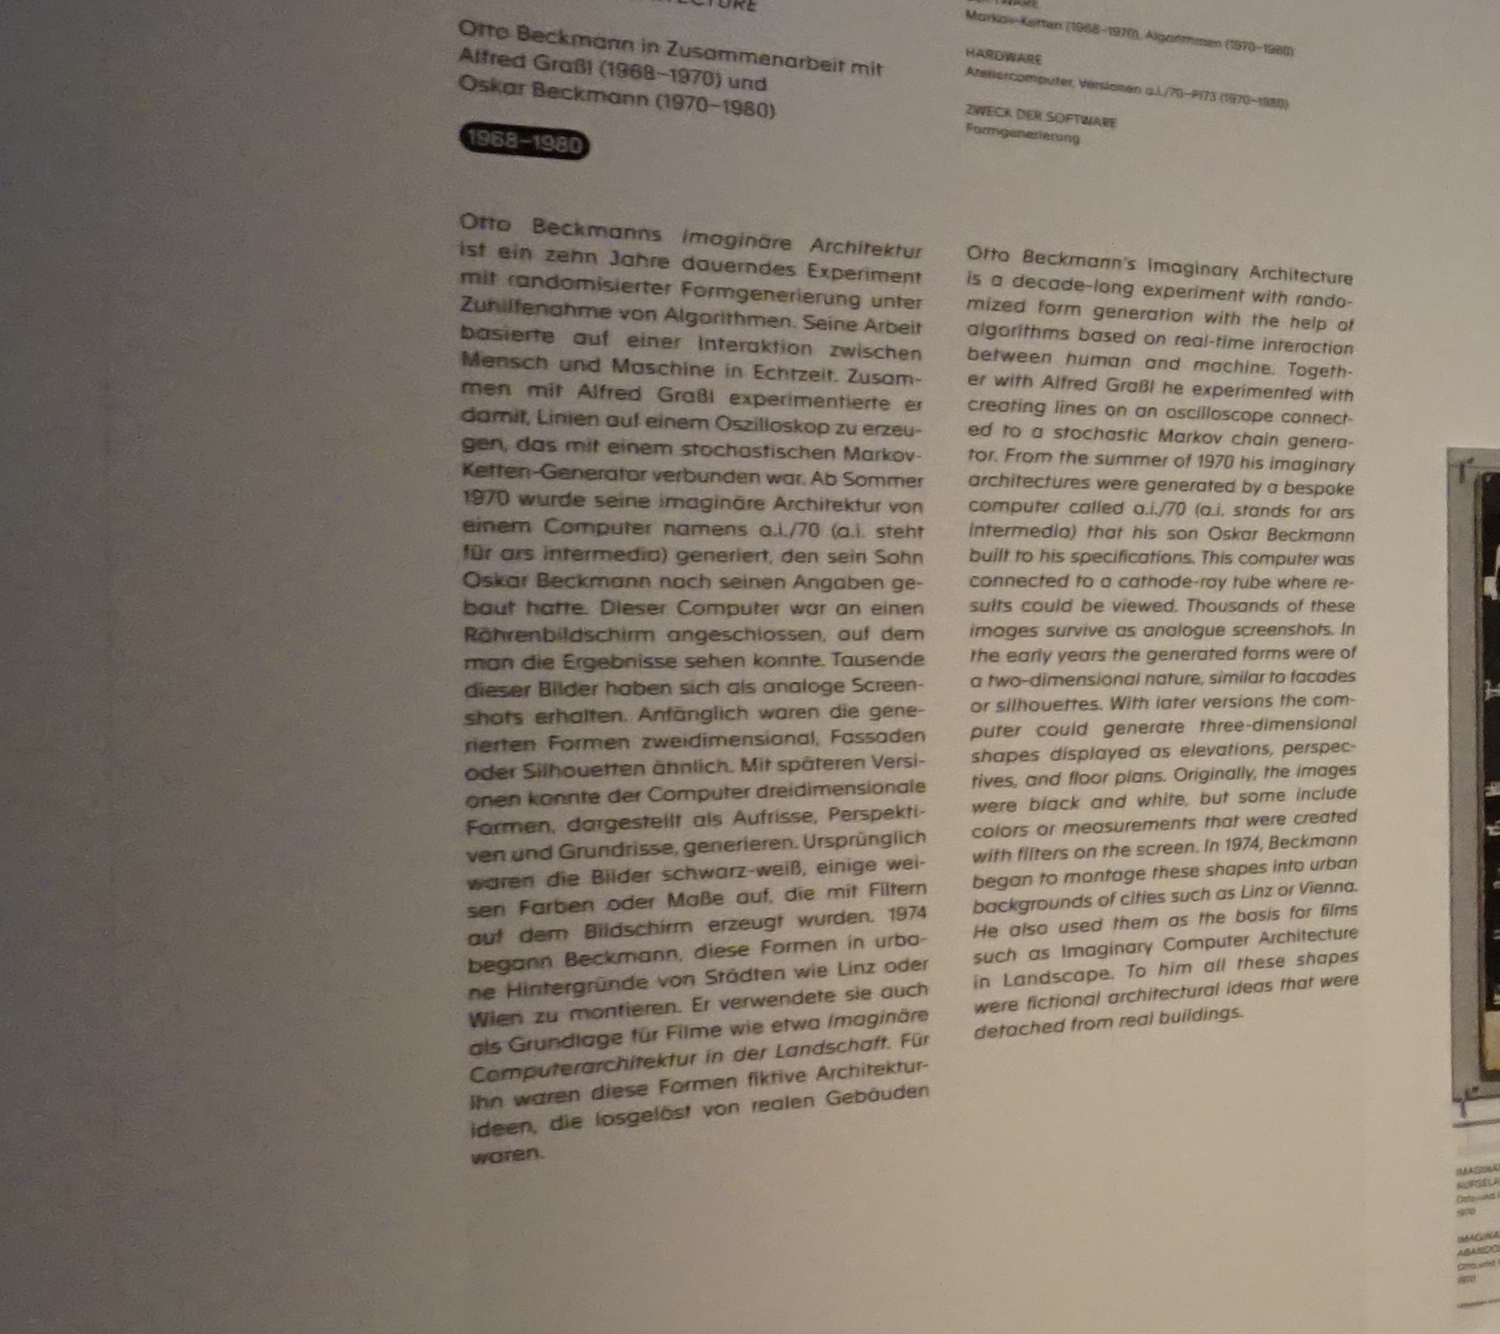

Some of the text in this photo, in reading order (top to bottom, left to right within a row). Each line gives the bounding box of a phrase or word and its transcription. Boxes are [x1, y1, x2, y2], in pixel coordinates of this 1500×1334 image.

[457, 18, 883, 77] Otto Beckmann in Zusammenarbeit mit
[964, 46, 1043, 66] HARDWARE
[458, 46, 527, 69] Alfred
[531, 53, 594, 76] Graßl
[727, 76, 768, 92] und
[457, 73, 529, 96] Oskar
[530, 80, 650, 107] Beckmann
[458, 211, 923, 259] Otto Beckmanns Imaginäre Architektur
[458, 240, 922, 284] ist ein zehn Jahre dauerndes Experiment
[966, 244, 1010, 263] Otto
[1147, 257, 1239, 281] Imaginary
[1249, 264, 1354, 286] Architecture
[459, 269, 923, 310] mit randomisierter Formgenerierung unter
[966, 269, 1353, 309] is a decade-long experiment with rando-
[459, 294, 923, 335] Zuhilfenahme von Algorithmen. Seine Arbeit
[966, 321, 1354, 356] algorithms based on real-time interaction
[967, 472, 1355, 498] architectures were generated by a bespoke
[461, 570, 923, 594] Oskar Beckmann nach seinen Angaben ge-
[969, 715, 1357, 742] puter could generate three-dimensional
[970, 741, 1356, 766] shapes displayed as elevations, perspec-
[971, 785, 1357, 815] were black and white, but some include
[464, 804, 926, 836] Formen, dargestellt als Aufrisse, Perspekti-
[465, 829, 926, 864] ven und Grundrisse, generieren. Ursprünglich
[972, 856, 1358, 892] began to montage these shapes into urban
[972, 927, 1359, 965] such as Imaginary Computer Architecture
[467, 957, 929, 1001] ne Hintergründe von Städten wie Linz oder
[469, 1032, 930, 1084] Computerarchitektur in der Landschaft. Für
[470, 1084, 929, 1139] ideen, die losgelöst von realen Gebäuden
